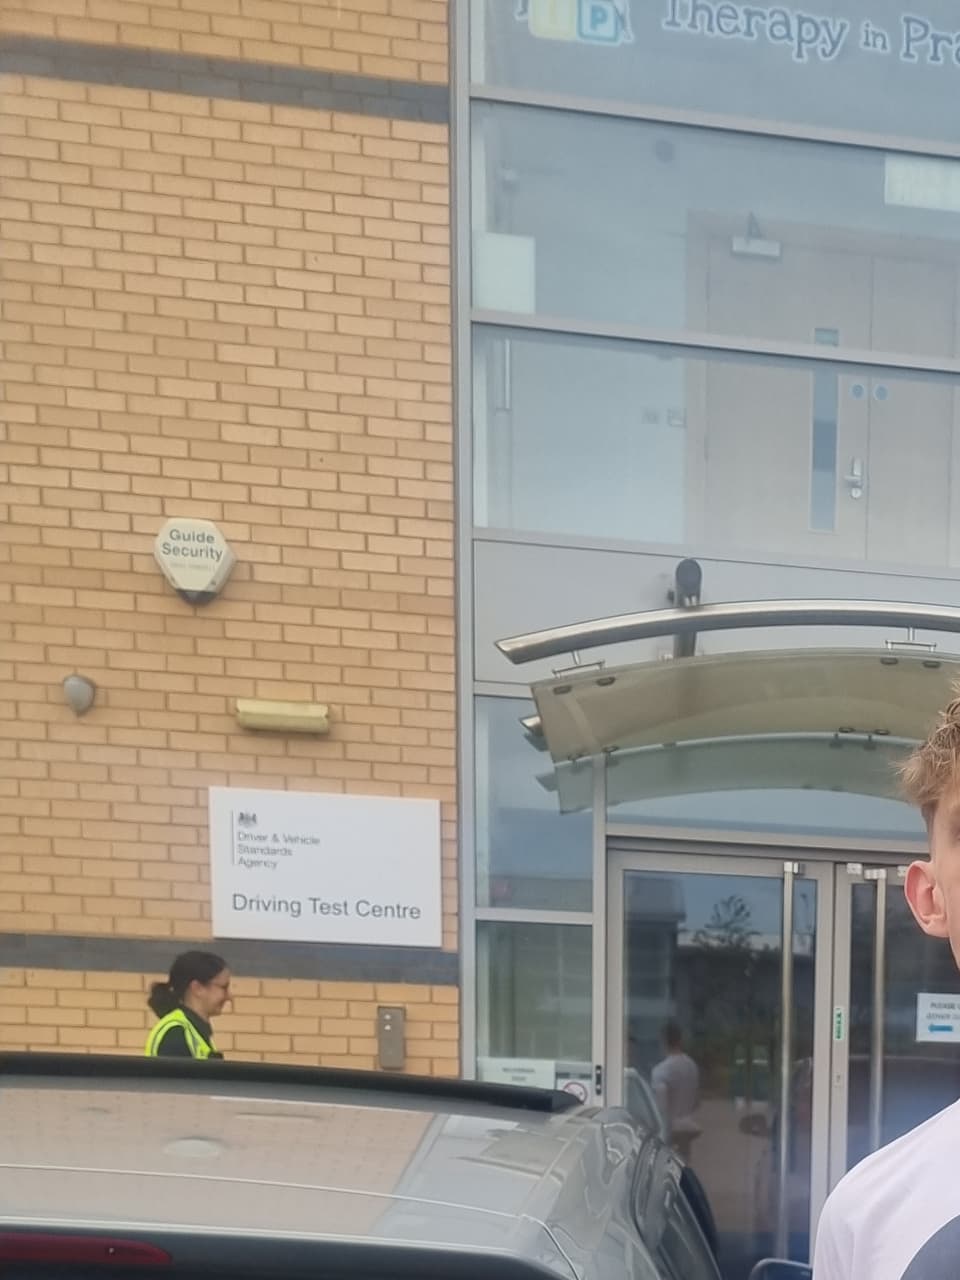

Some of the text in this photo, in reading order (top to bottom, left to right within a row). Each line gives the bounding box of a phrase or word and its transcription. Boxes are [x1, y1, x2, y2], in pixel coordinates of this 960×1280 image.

[662, 0, 848, 60] Therapy
[861, 21, 889, 52] in
[169, 528, 215, 543] Guide
[161, 542, 223, 562] Security
[238, 832, 268, 841] Driver
[283, 833, 321, 845] Vehicle
[238, 844, 293, 856] Standards
[238, 856, 277, 869] Agency
[232, 893, 421, 920] Driving Test Centre
